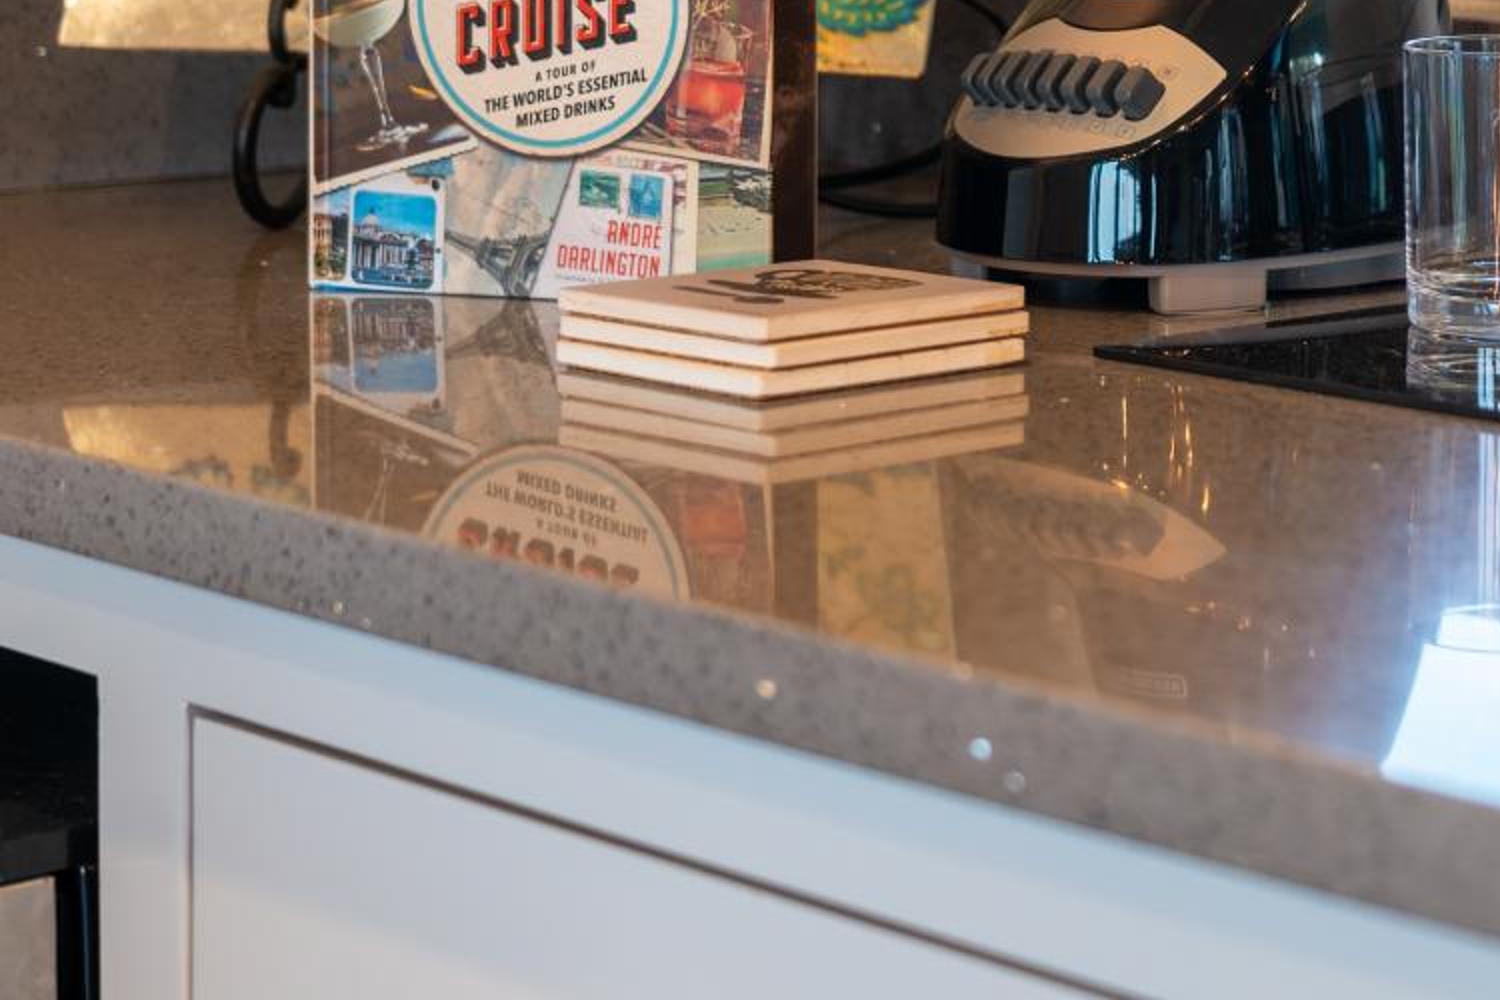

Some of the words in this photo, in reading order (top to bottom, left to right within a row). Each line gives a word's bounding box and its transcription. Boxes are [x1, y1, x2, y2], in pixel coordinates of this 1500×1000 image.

[535, 71, 543, 83] A
[546, 63, 577, 80] TOUR
[581, 60, 597, 73] OF
[484, 96, 509, 114] THE
[512, 81, 575, 108] WORLD'S
[578, 68, 648, 95] ESSENTIAL
[515, 107, 561, 129] MIXED
[564, 95, 616, 120] DRINKS
[556, 244, 661, 280] DARLINGTON
